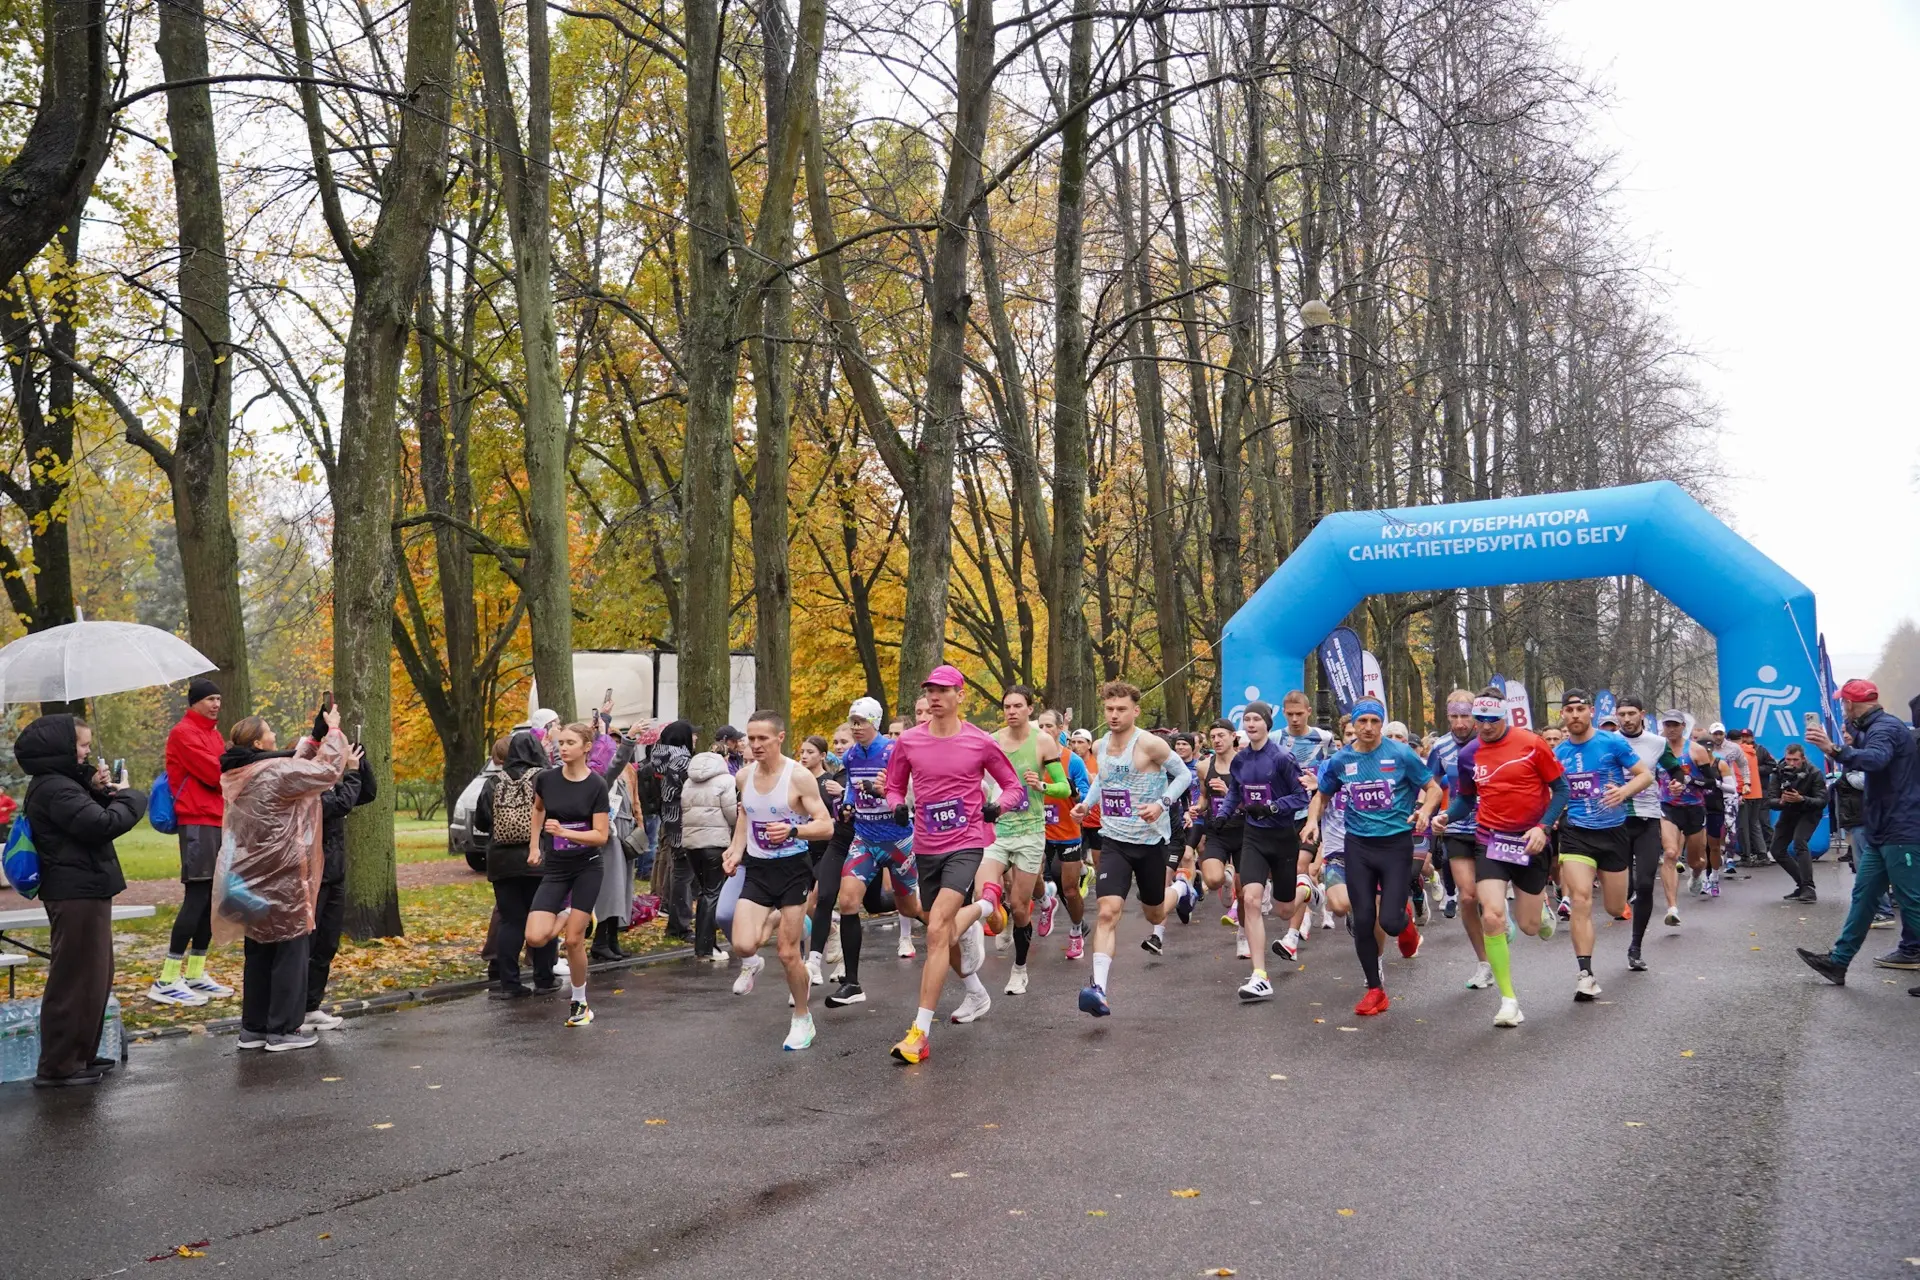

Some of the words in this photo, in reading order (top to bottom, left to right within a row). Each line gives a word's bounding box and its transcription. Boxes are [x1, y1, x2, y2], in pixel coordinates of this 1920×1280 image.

[1381, 520, 1444, 539] КУБОК
[1449, 508, 1589, 534] ГУБЕРНАТОРА
[1349, 532, 1537, 562] САНКТ-ПЕТЕРБУРГА
[1541, 530, 1572, 548] ПО
[1577, 524, 1628, 545] БЕГУ
[1571, 780, 1592, 790] 309
[1250, 792, 1262, 801] 52
[1358, 790, 1386, 802] 1016
[1105, 799, 1127, 808] 5015
[933, 809, 956, 822] 186
[1494, 841, 1525, 855] 7055
